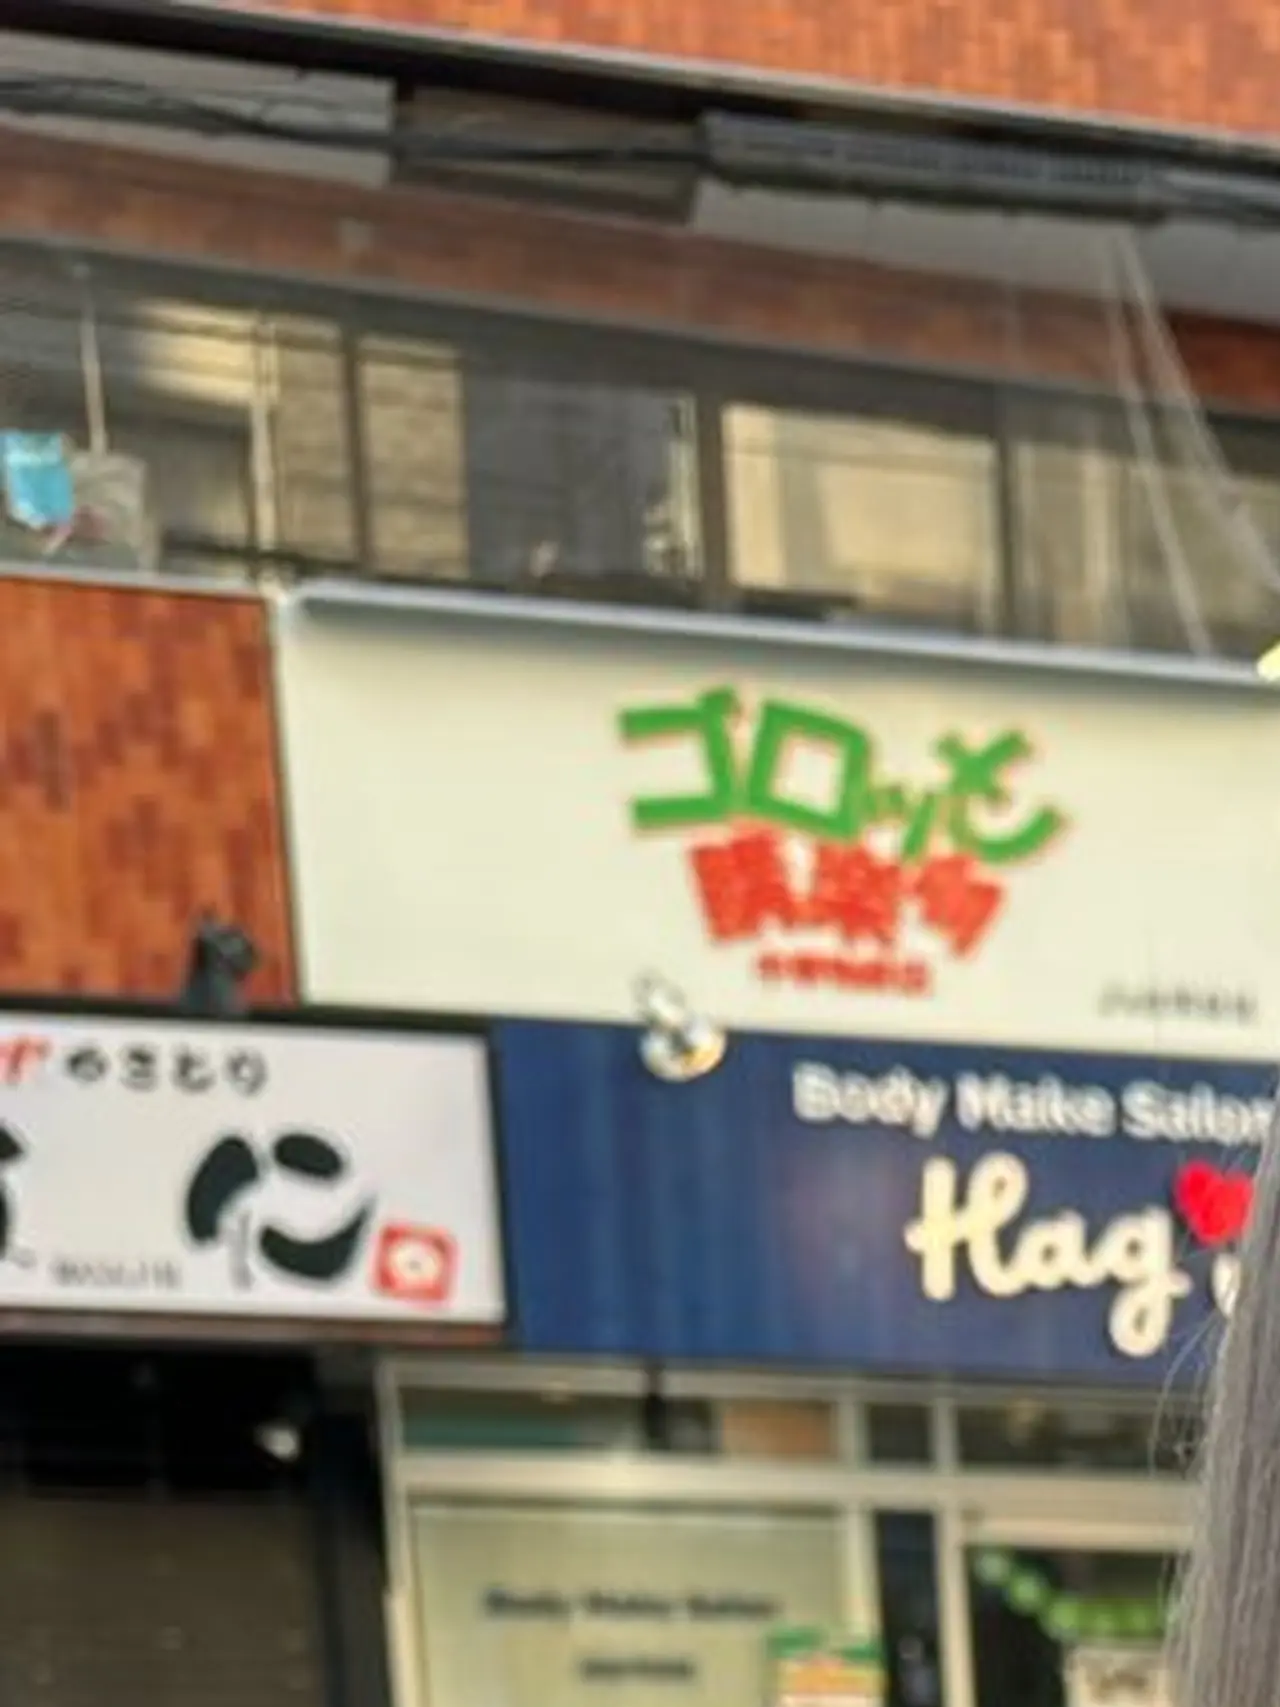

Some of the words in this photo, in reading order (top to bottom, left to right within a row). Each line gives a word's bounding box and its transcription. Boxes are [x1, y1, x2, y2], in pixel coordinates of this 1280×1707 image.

[793, 1062, 948, 1139] Body
[955, 1070, 1117, 1137] Make
[904, 1152, 1193, 1358] Hag
